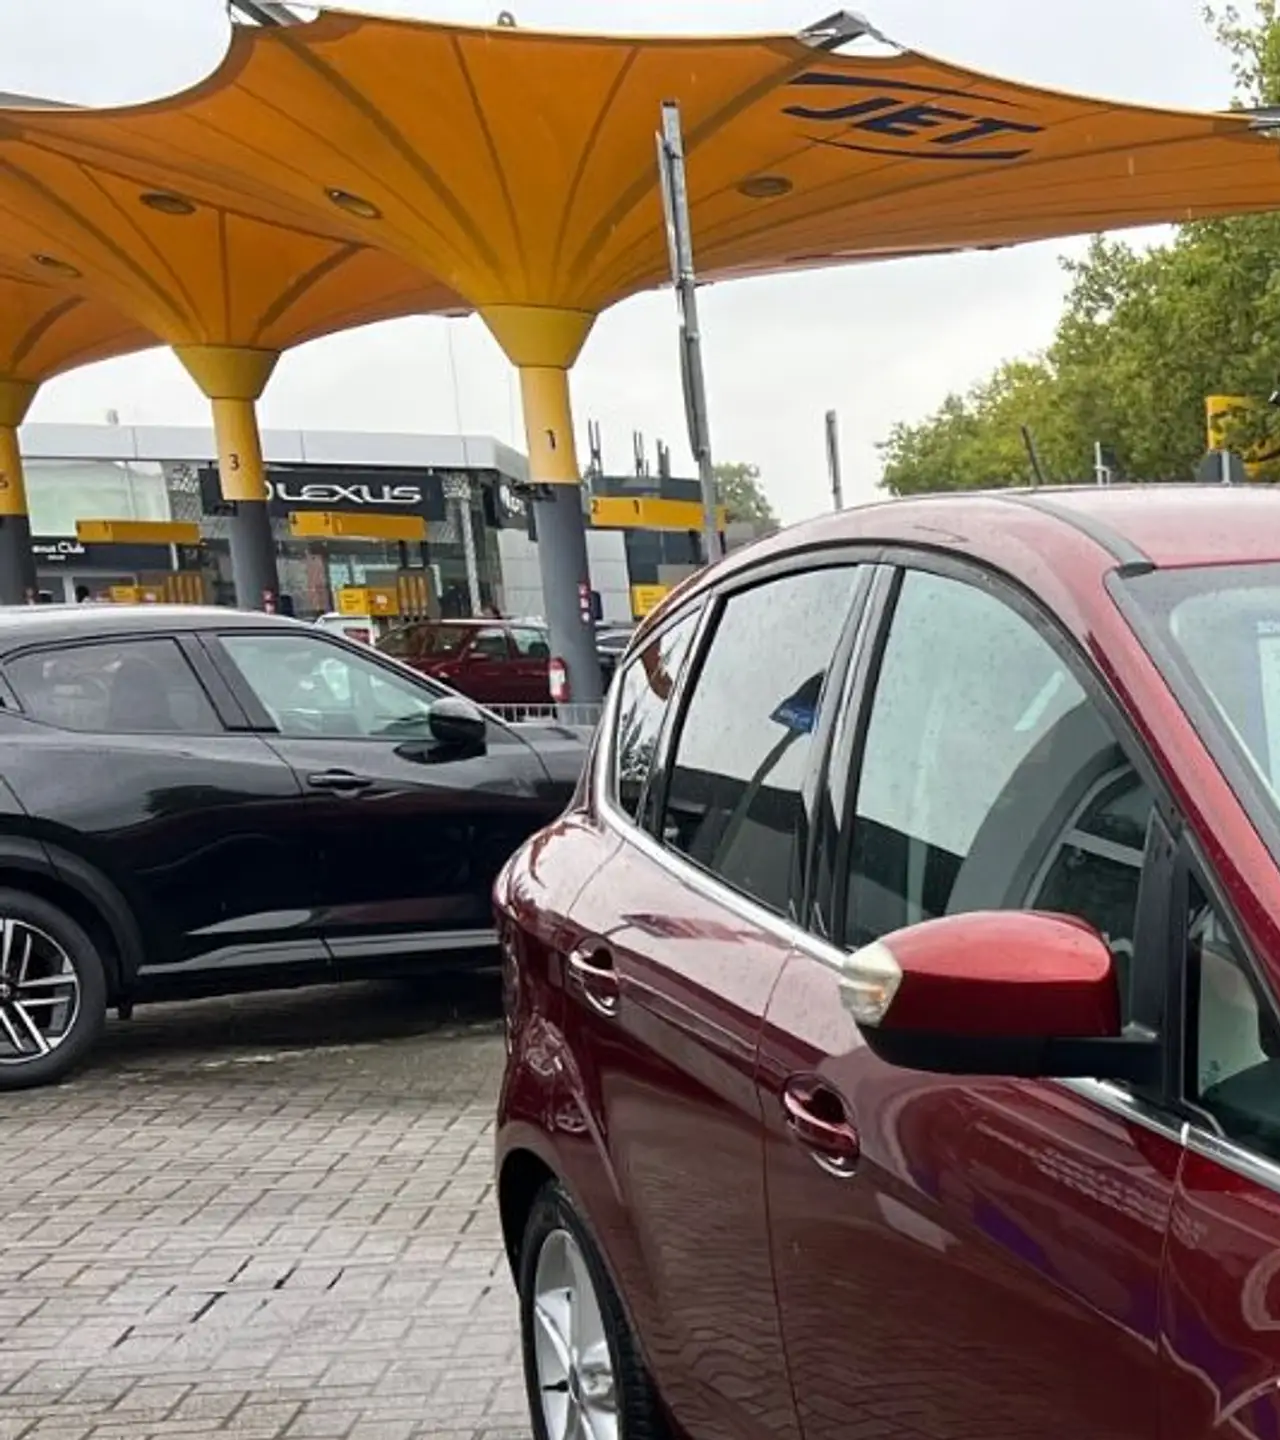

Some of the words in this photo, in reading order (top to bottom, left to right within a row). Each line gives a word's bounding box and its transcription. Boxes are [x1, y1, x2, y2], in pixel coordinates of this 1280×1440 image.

[781, 96, 1047, 144] JET
[546, 429, 557, 450] 1
[229, 453, 240, 471] 3
[276, 482, 422, 505] LEXUS
